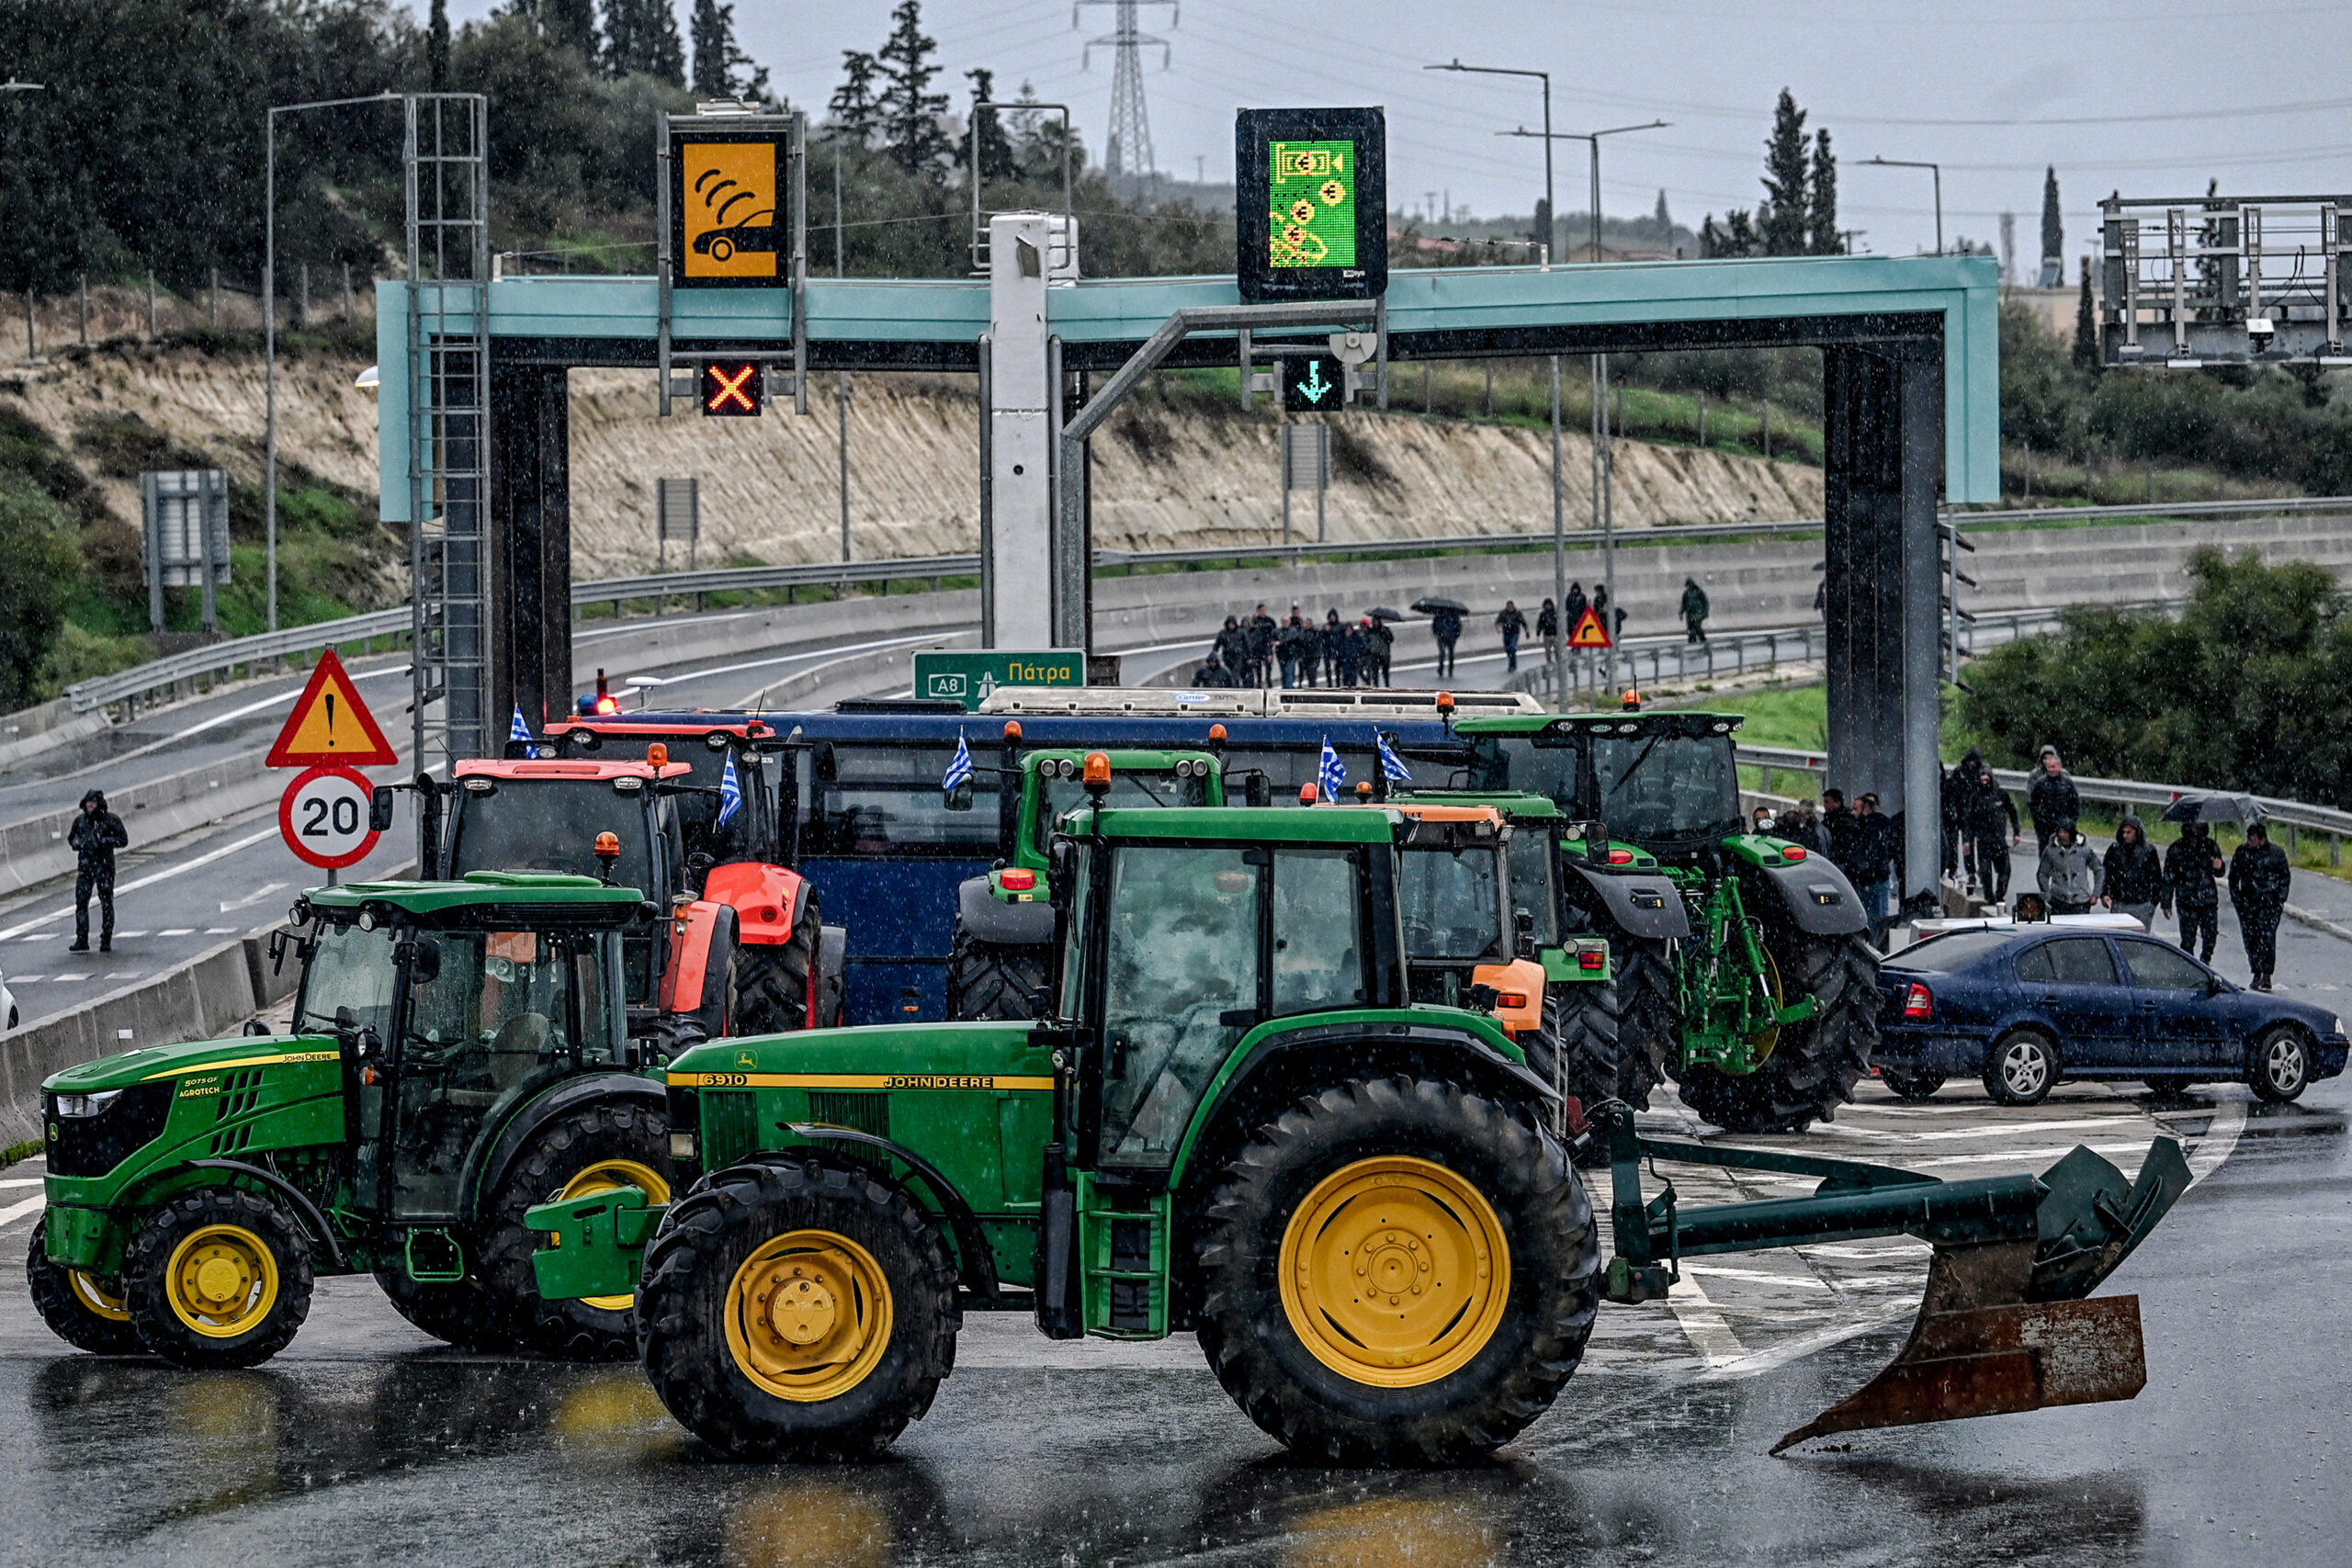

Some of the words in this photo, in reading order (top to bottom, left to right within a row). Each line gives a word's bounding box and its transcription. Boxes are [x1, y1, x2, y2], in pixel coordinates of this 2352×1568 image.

[1009, 662, 1070, 684] Πάτρα
[937, 679, 958, 693] A8
[302, 795, 358, 837] 20
[283, 1055, 305, 1063] JOHN
[305, 1053, 332, 1061] DEERE
[703, 1074, 748, 1087] 6910
[883, 1077, 933, 1089] JOHN
[935, 1077, 992, 1089] DEERE
[178, 1086, 220, 1098] AGROTECH
